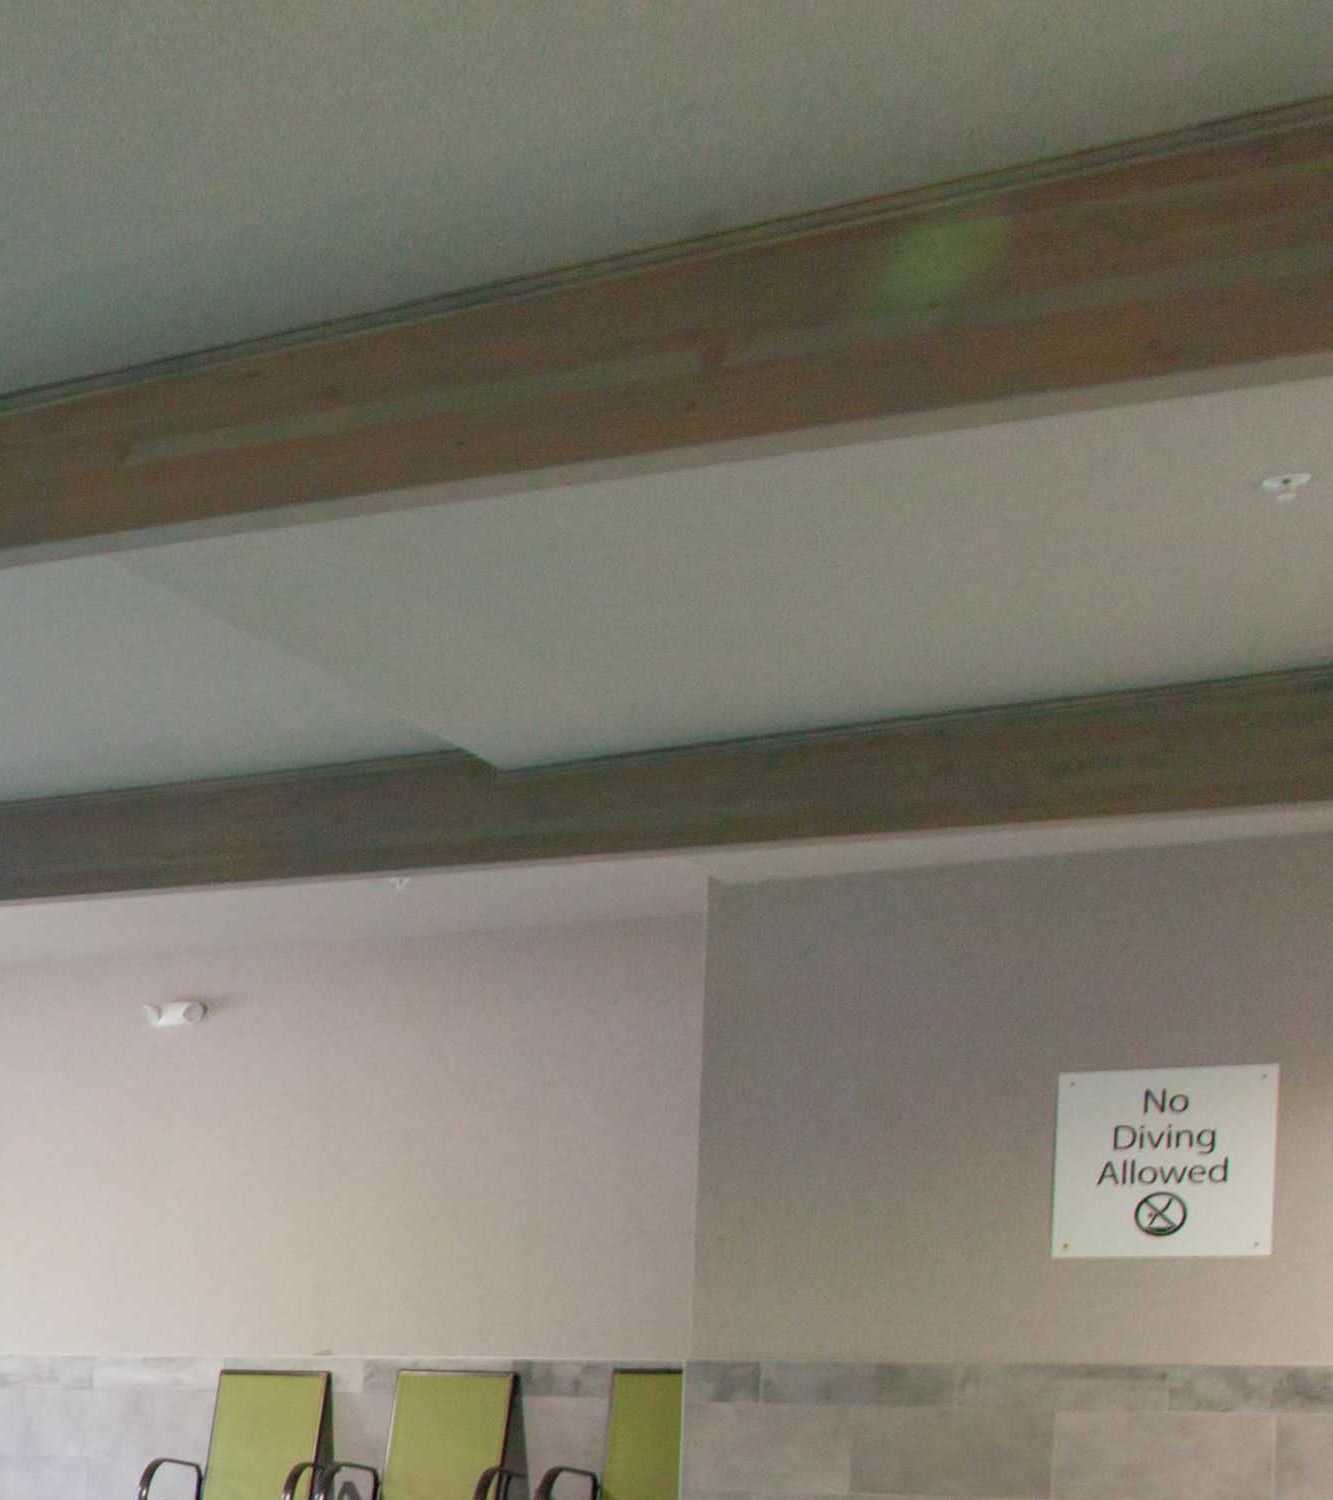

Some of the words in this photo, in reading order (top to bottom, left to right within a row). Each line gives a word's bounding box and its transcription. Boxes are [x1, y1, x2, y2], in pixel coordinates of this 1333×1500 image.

[1143, 1088, 1189, 1114] No
[1113, 1124, 1216, 1154] Diving
[1096, 1156, 1229, 1185] Allowed
